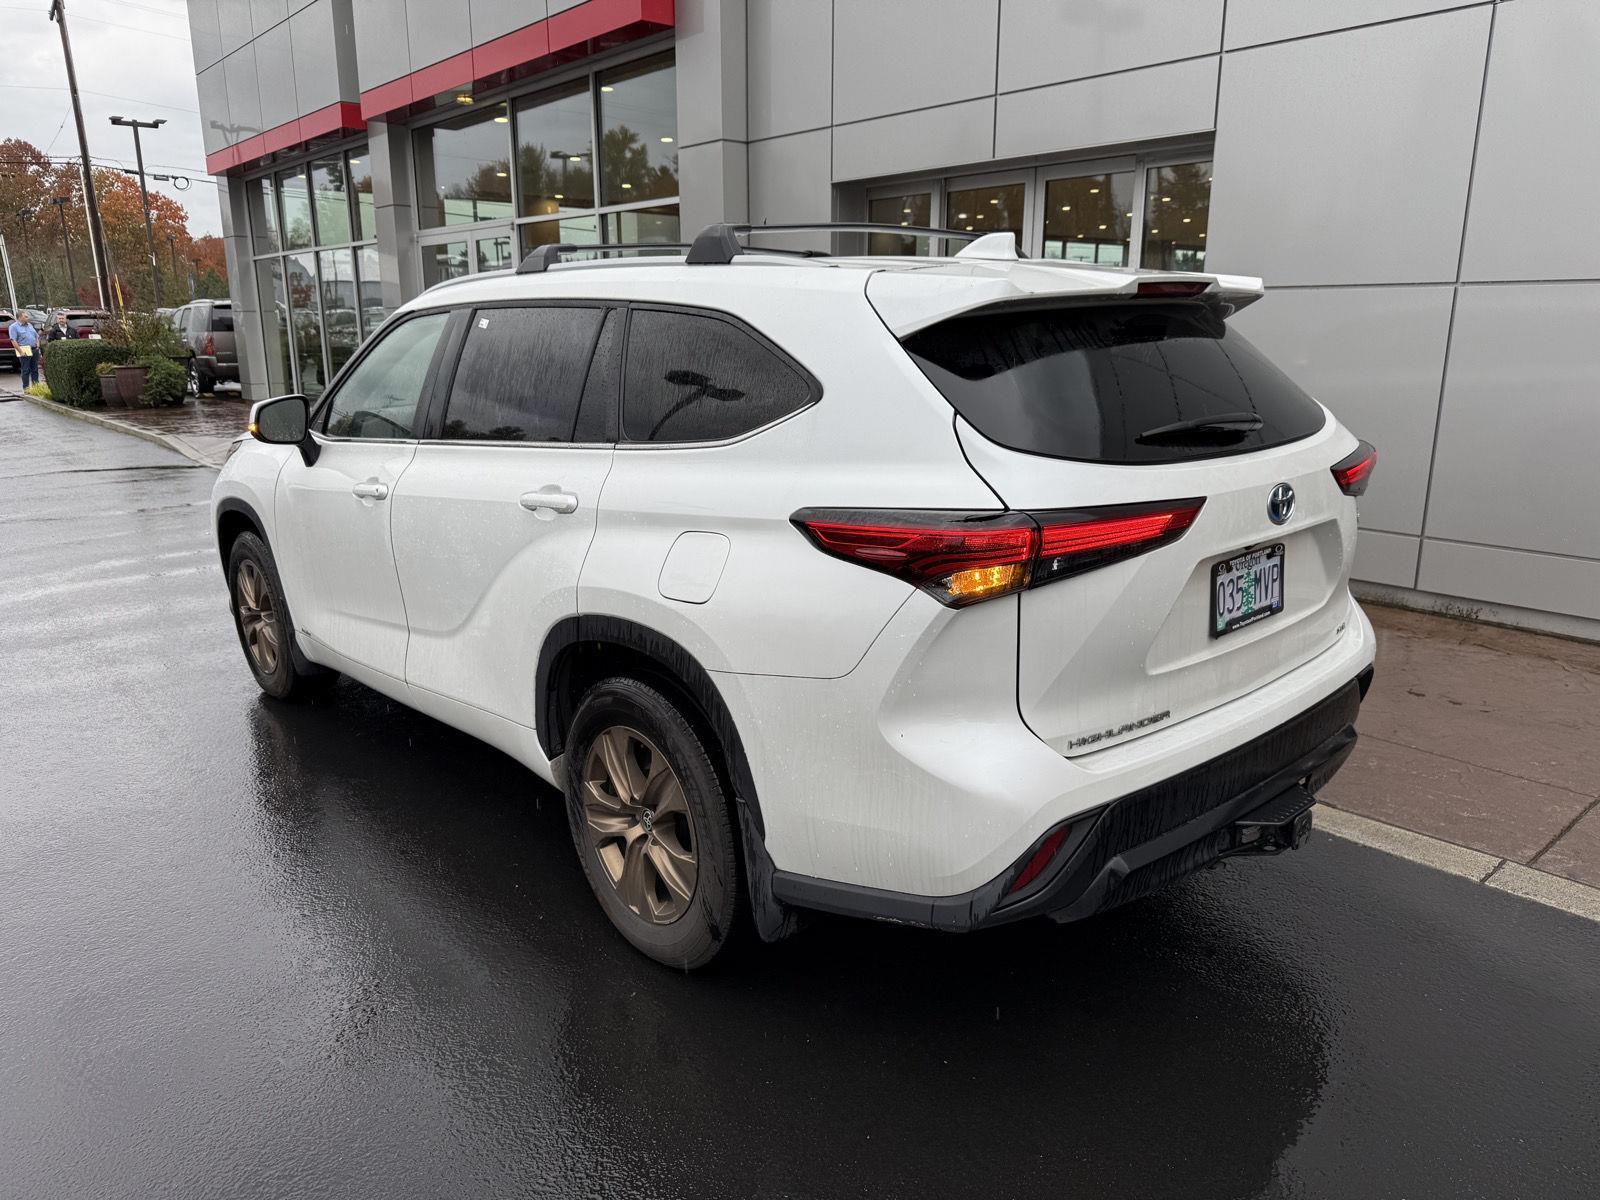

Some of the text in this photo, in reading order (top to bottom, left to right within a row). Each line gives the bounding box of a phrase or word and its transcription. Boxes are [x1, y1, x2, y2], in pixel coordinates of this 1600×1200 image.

[1217, 563, 1279, 617] 035 MVP
[1067, 709, 1170, 750] HIGHLANDER
